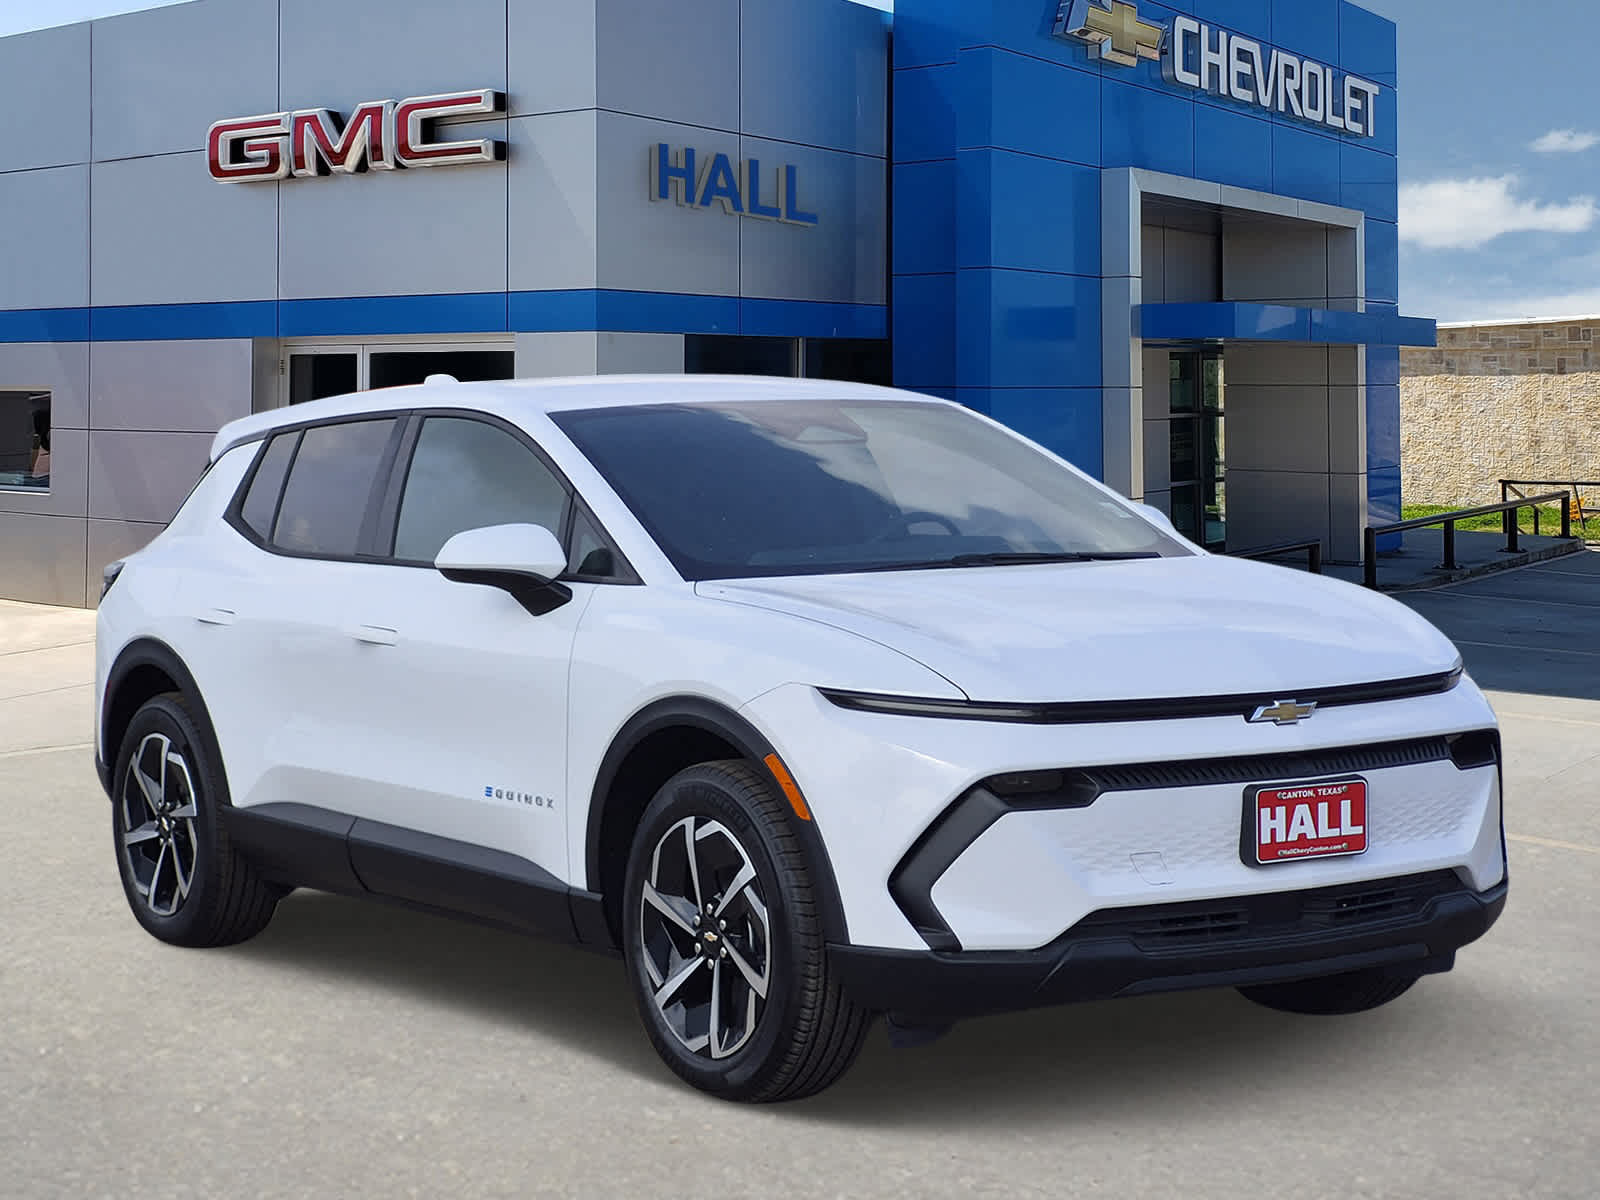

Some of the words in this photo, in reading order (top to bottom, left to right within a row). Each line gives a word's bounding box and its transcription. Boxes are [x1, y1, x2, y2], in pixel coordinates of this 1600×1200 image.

[1174, 15, 1379, 137] CHEVROLET
[207, 88, 505, 184] GMC
[653, 143, 819, 225] HALL
[484, 786, 554, 809] EQUINOX
[1260, 799, 1364, 845] HALL
[1282, 789, 1316, 800] CANTON,
[1318, 787, 1343, 796] TEXAS
